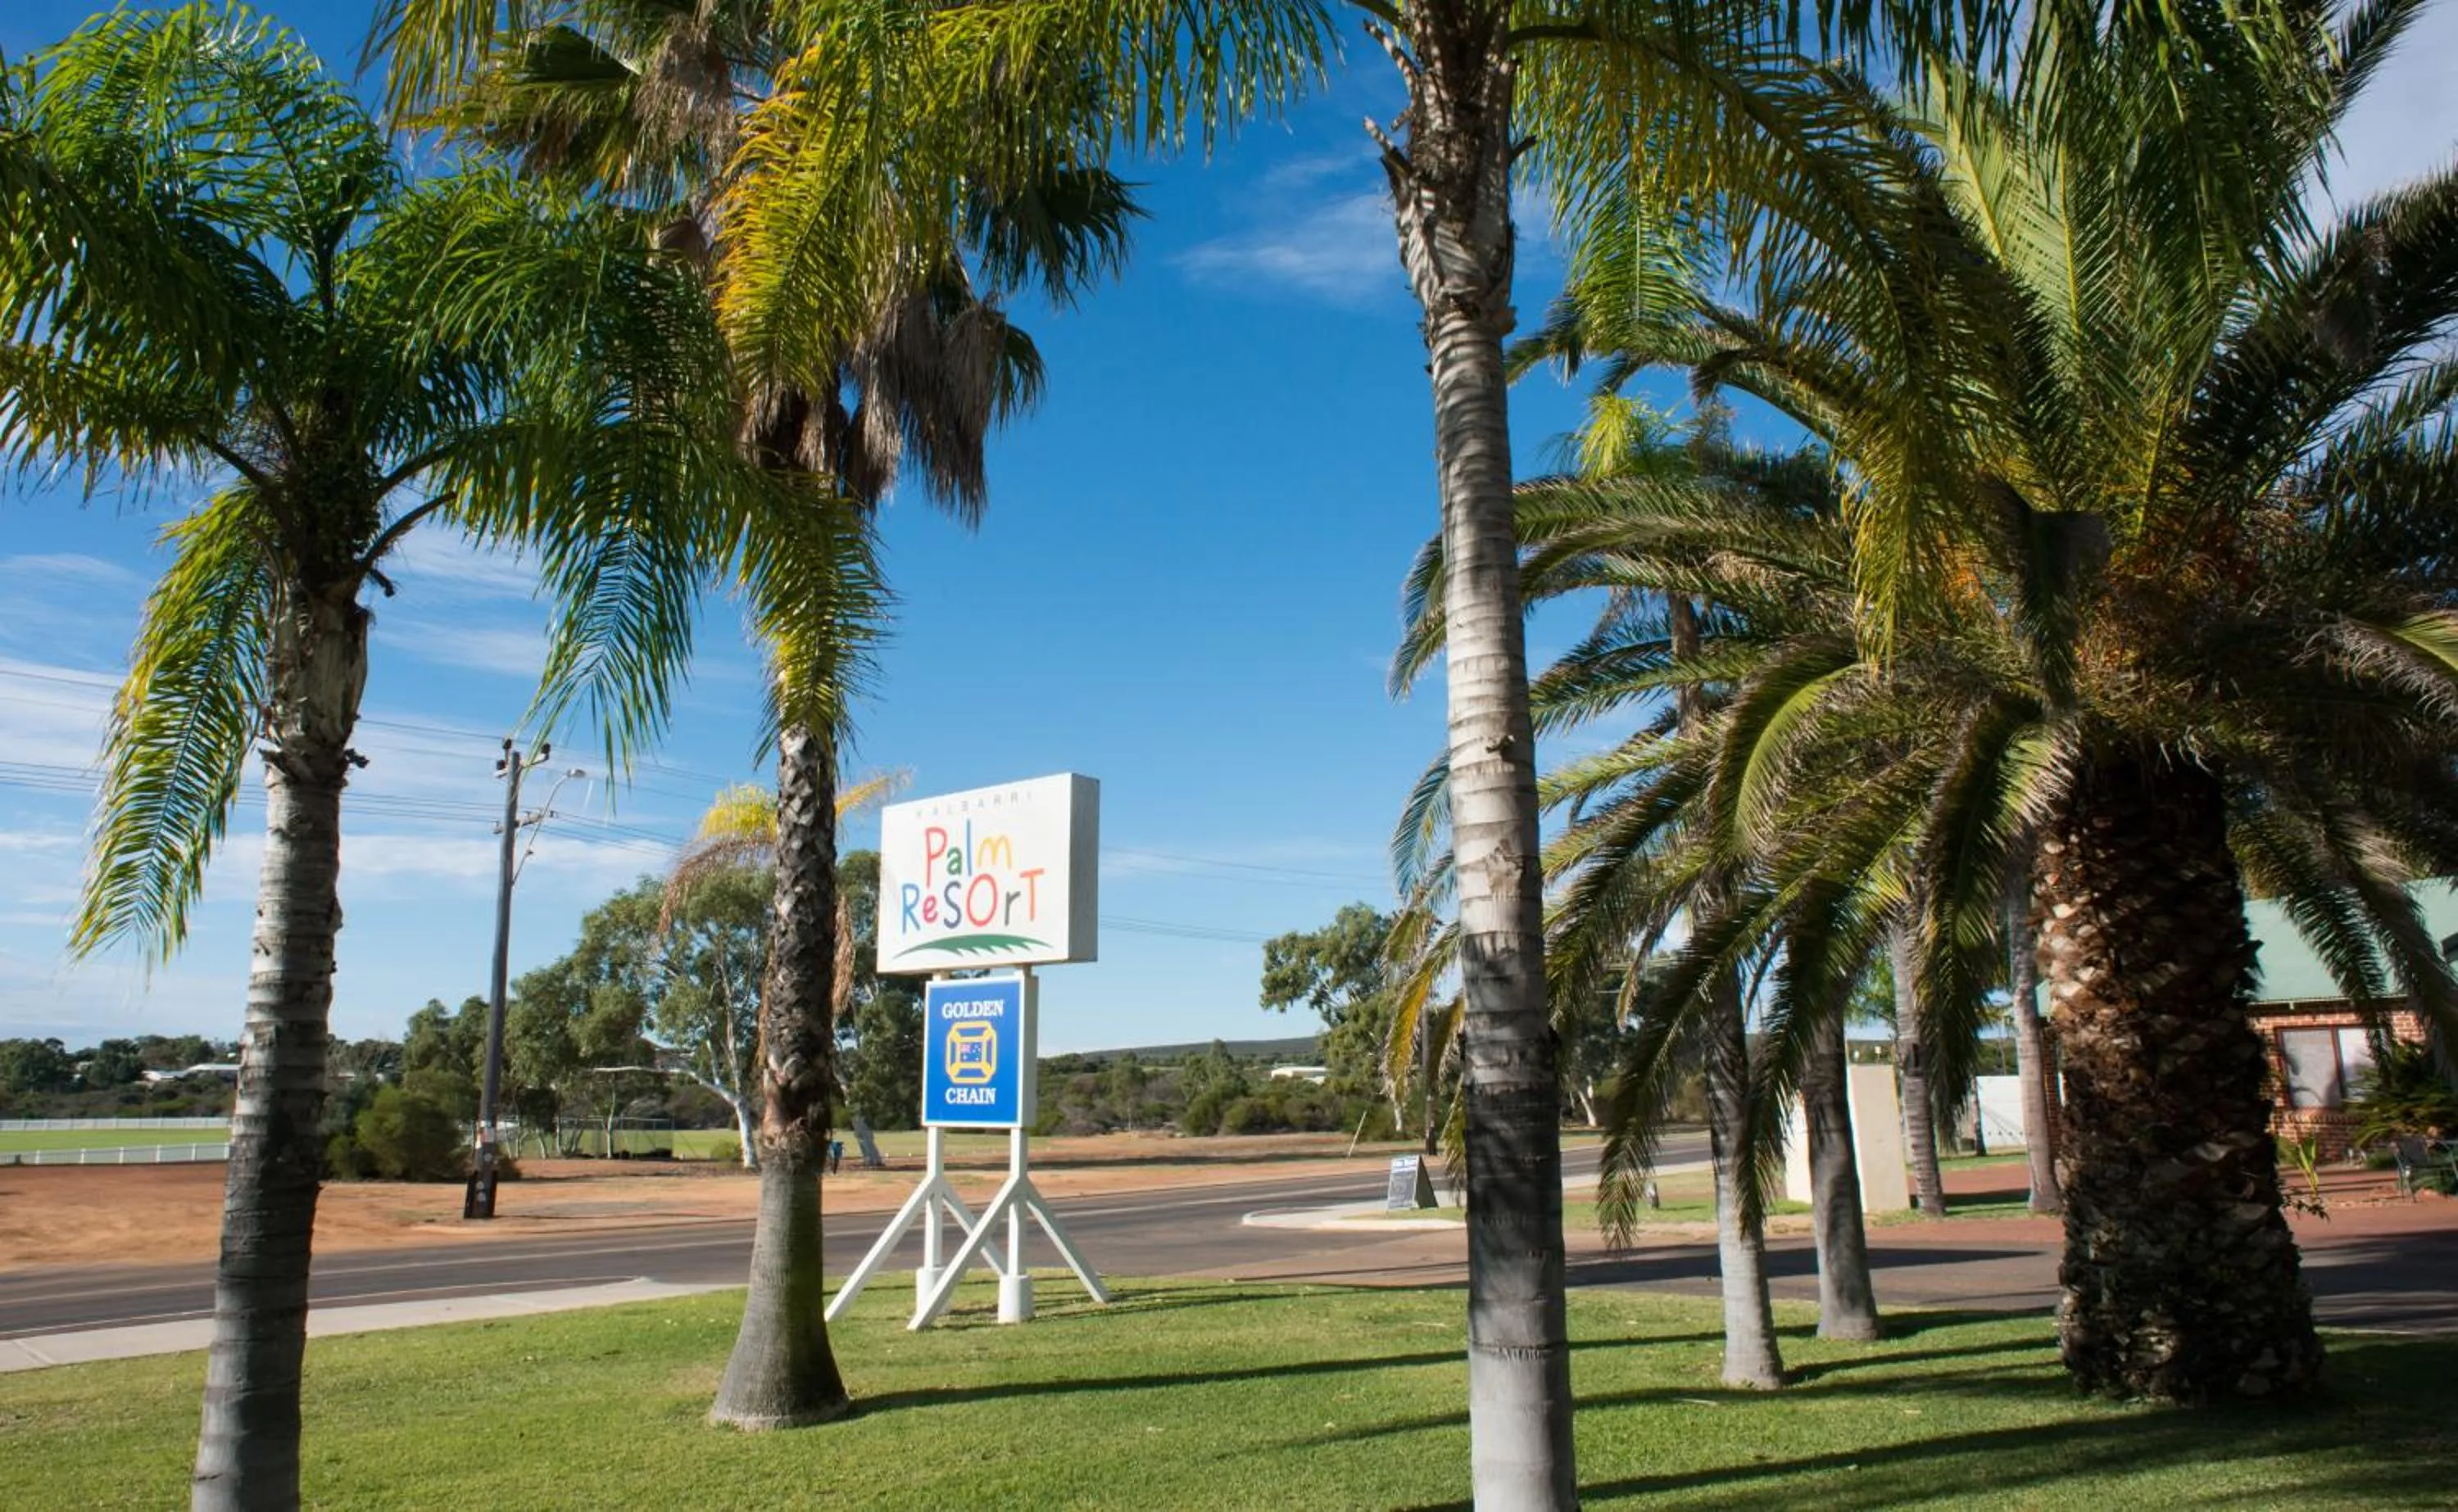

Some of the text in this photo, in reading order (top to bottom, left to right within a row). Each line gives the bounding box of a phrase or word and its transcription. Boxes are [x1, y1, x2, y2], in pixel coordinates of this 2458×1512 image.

[924, 819, 1013, 889] Palm
[941, 999, 1005, 1019] GOLDEN
[946, 1087, 996, 1104] CHAIN
